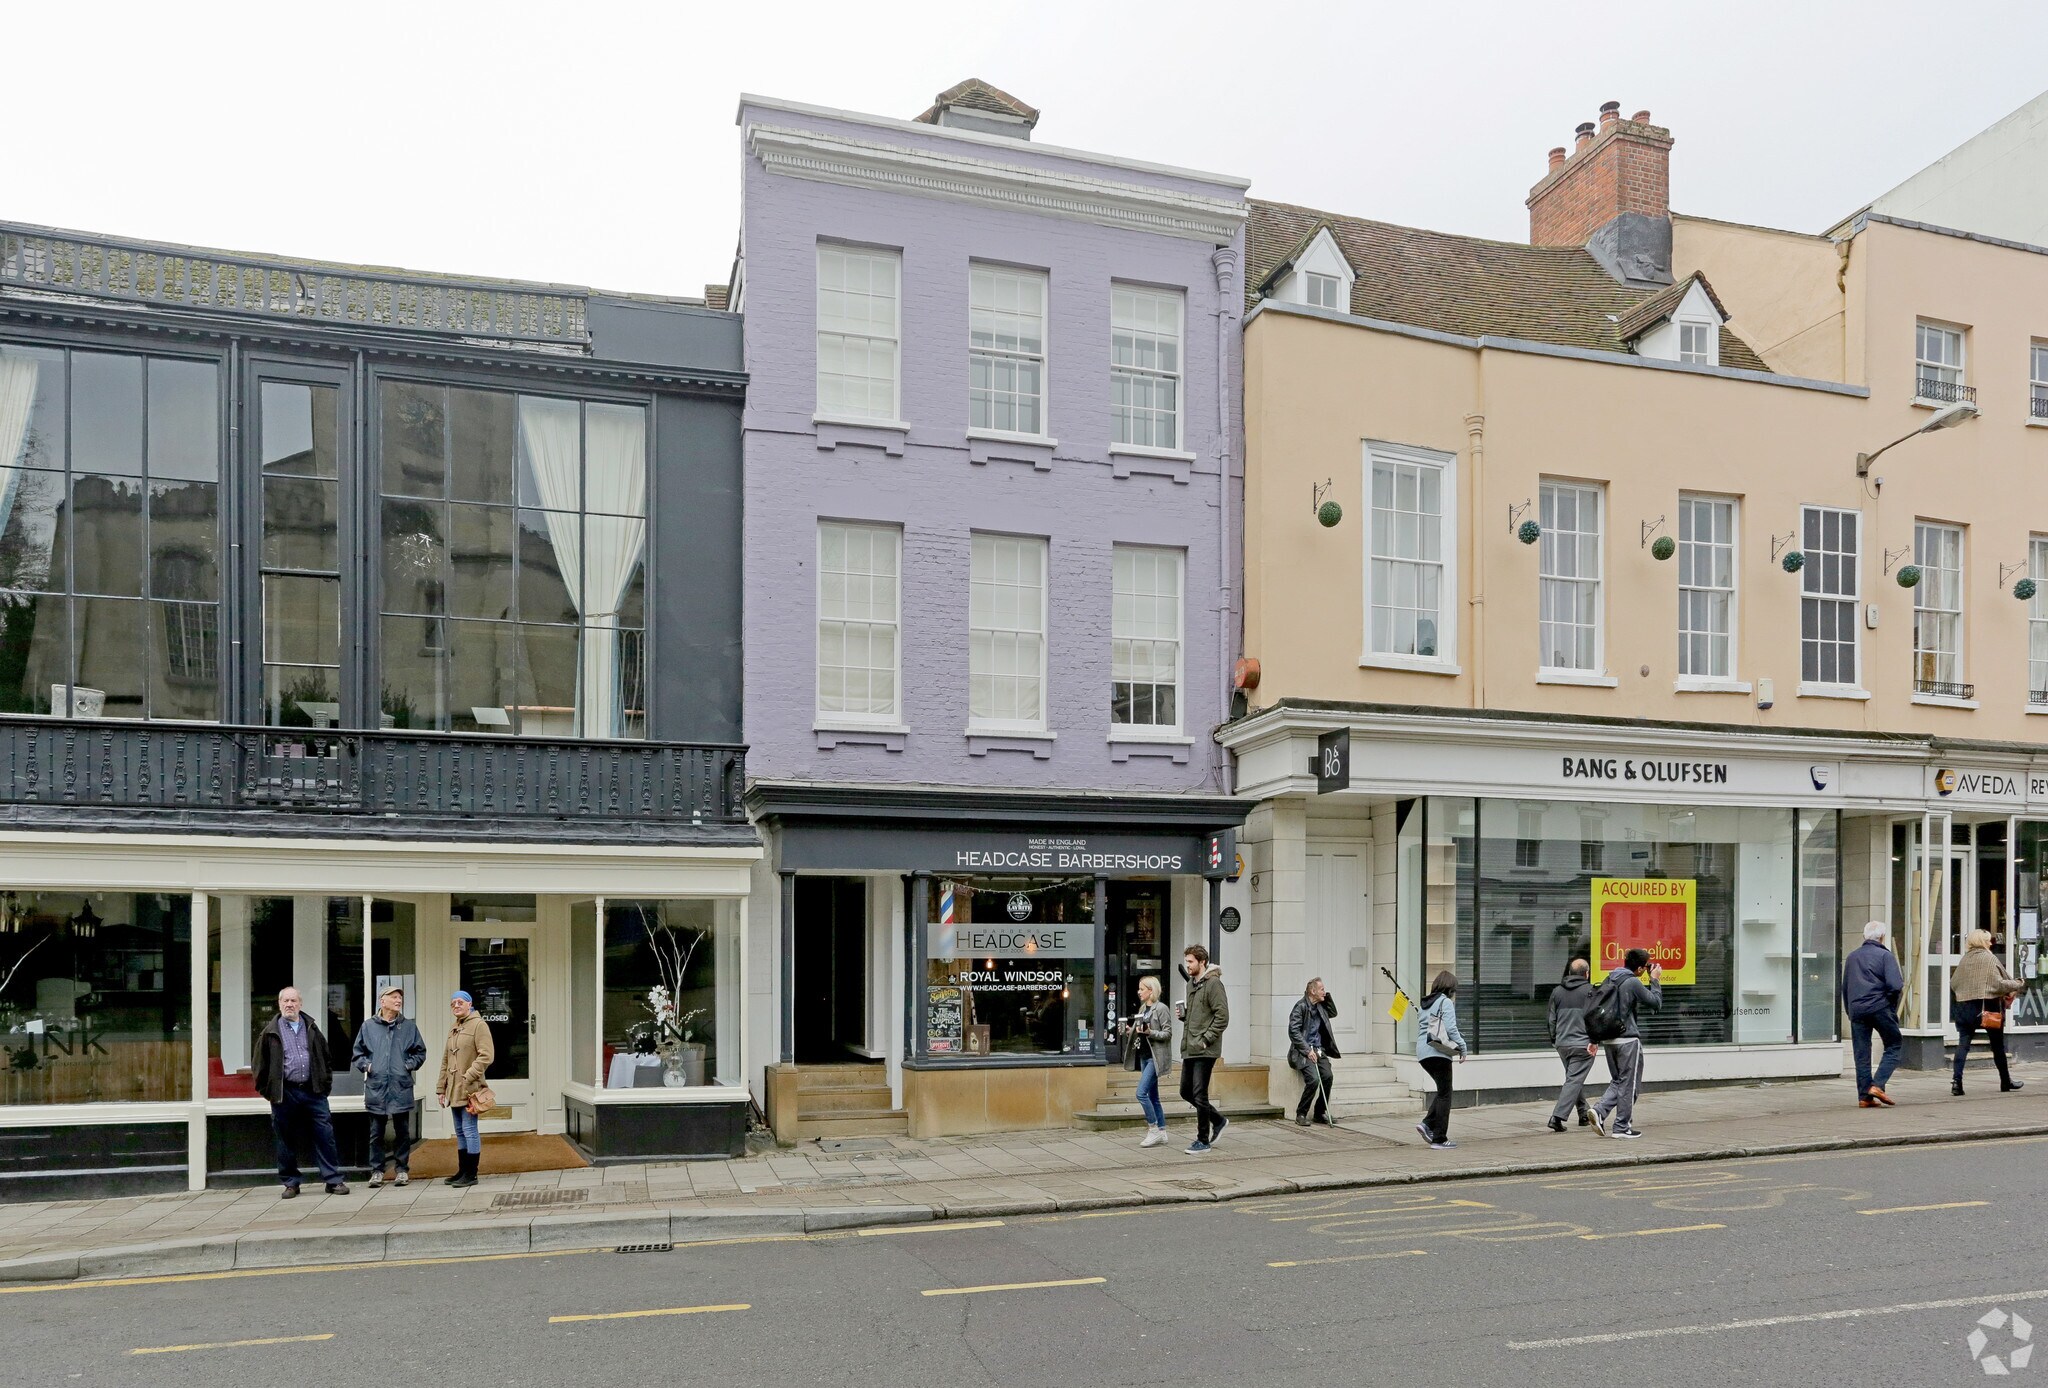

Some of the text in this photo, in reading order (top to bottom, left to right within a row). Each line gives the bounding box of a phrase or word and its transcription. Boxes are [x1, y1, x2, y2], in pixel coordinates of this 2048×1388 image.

[1563, 757, 1727, 784] BANG & OLUFSEN
[1957, 774, 2017, 796] AVEDA
[2031, 778, 2048, 795] RE
[1056, 839, 1087, 847] ENGLAND
[956, 851, 1182, 870] HEADCASE BARBERSHOPS
[1602, 882, 1687, 898] ACQUIRED BY
[956, 931, 1067, 949] HEADCASE
[960, 971, 1062, 982] ROYAL WINDSOR
